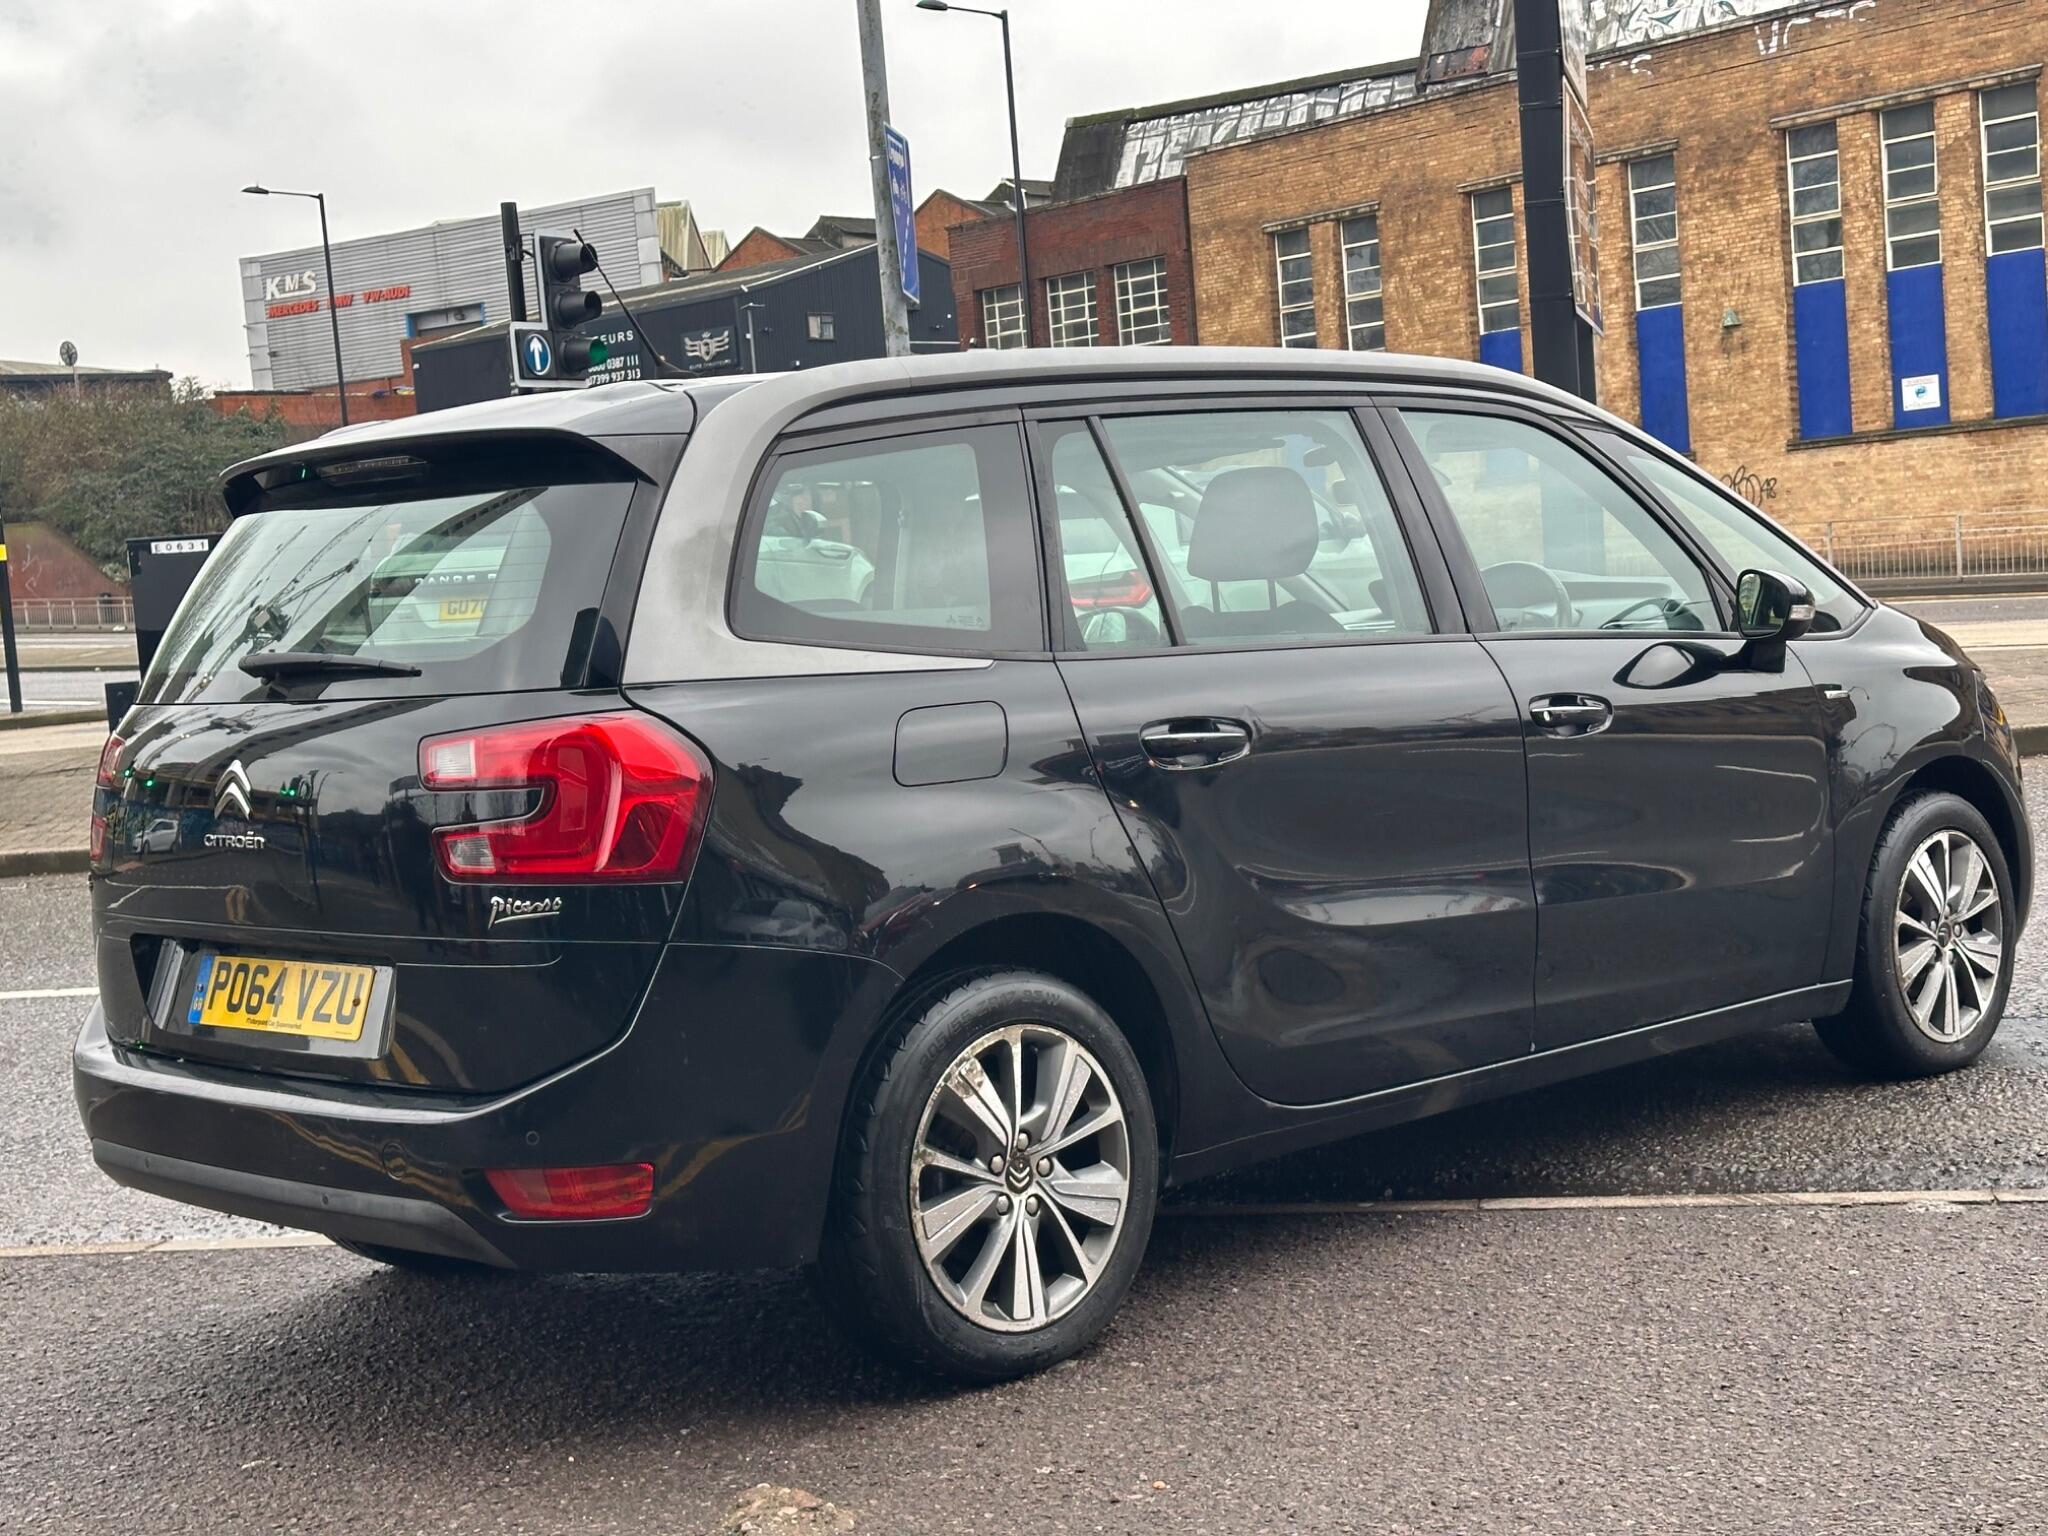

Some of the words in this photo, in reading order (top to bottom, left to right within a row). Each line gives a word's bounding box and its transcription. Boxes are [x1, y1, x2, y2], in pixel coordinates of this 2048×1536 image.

[266, 270, 317, 300] KMS
[268, 300, 320, 318] MERCEDES
[326, 294, 354, 309] MW
[626, 354, 639, 367] 111
[610, 370, 625, 382] 937
[626, 368, 641, 380] 313
[154, 541, 205, 553] E0631
[204, 830, 265, 849] CITROËN
[487, 895, 563, 930] Picasso
[207, 960, 289, 1018] PO64
[297, 968, 364, 1025] VZU
